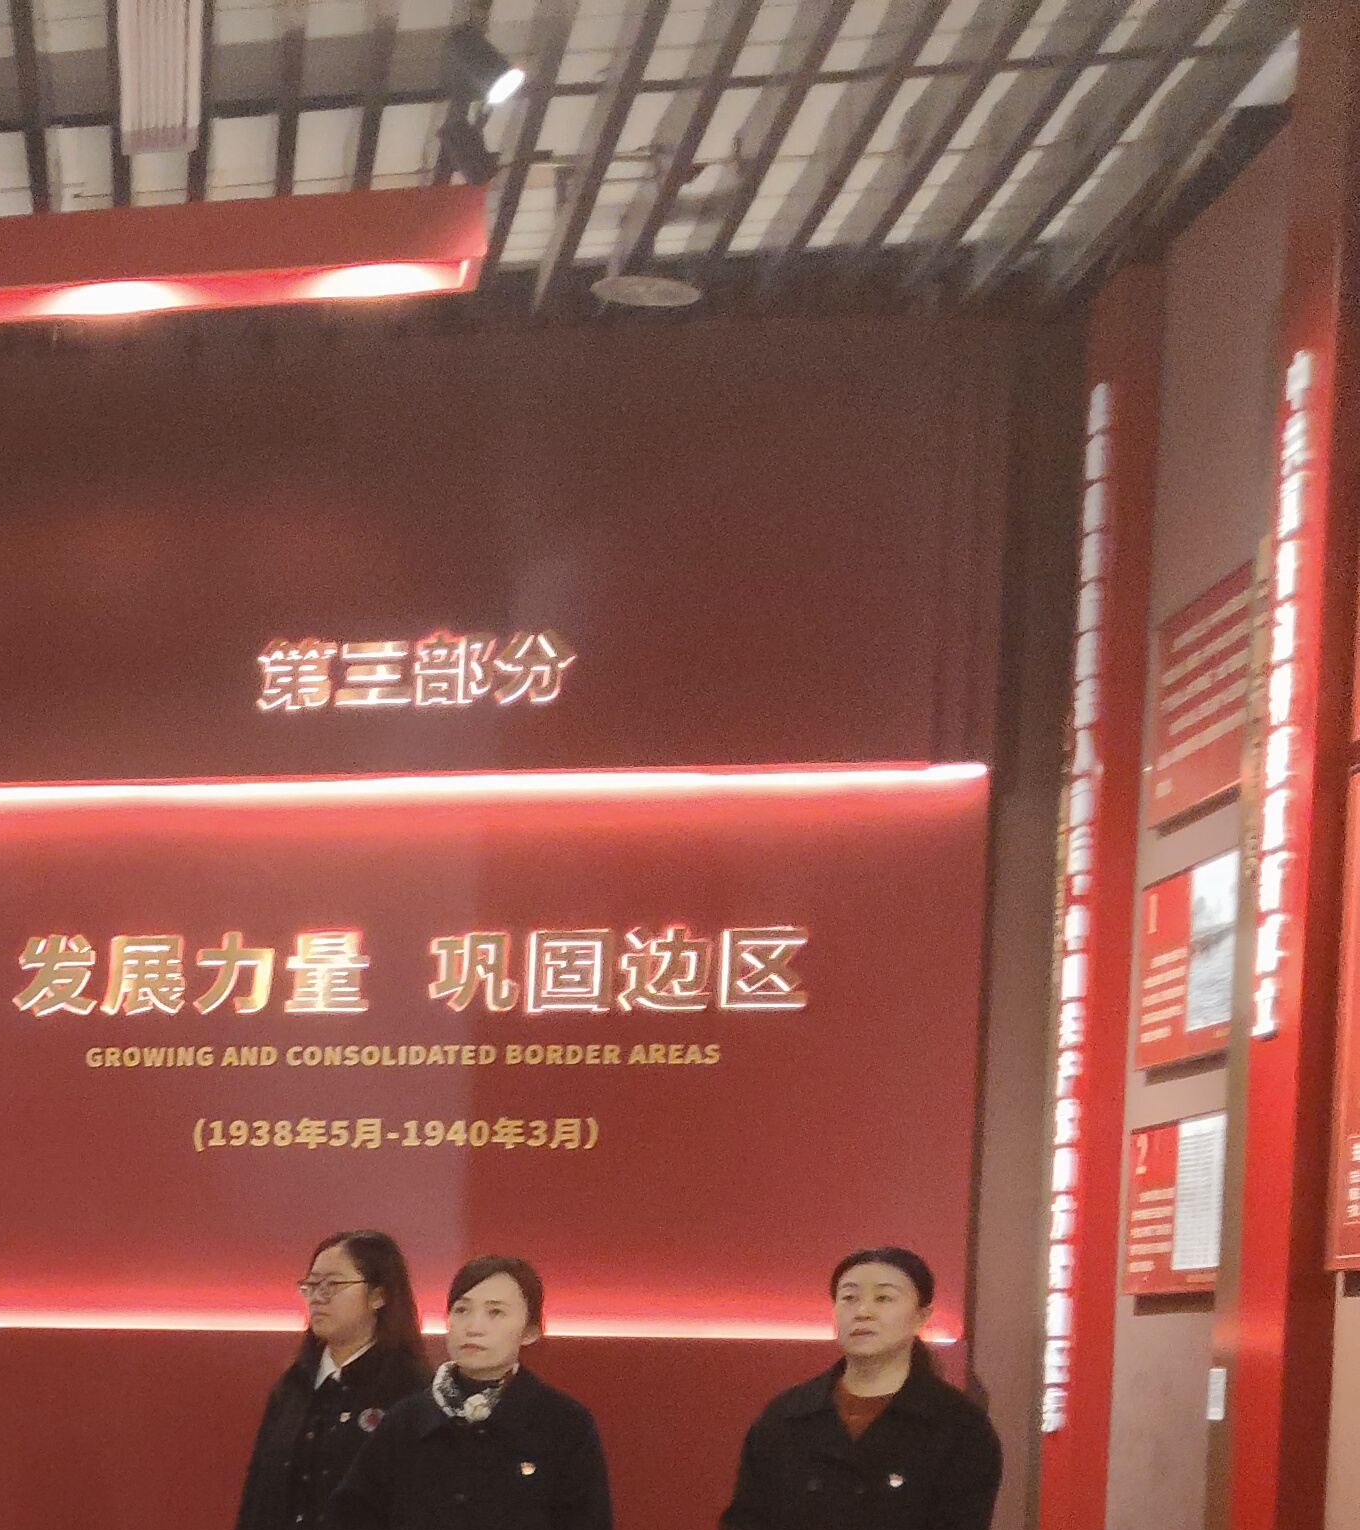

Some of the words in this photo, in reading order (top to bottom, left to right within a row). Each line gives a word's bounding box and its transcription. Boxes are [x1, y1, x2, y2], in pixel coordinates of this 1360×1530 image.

[257, 630, 578, 711] 第三部分
[12, 931, 371, 1017] 发展力量
[428, 925, 810, 1014] 巩固边区
[85, 1045, 214, 1067] GROWING
[221, 1045, 278, 1067] AND
[286, 1043, 496, 1067] CONSOLIDATED
[505, 1043, 621, 1065] BORDER
[628, 1043, 721, 1065] AREAS
[193, 1117, 600, 1152] (1938年5月-1940年3月)
